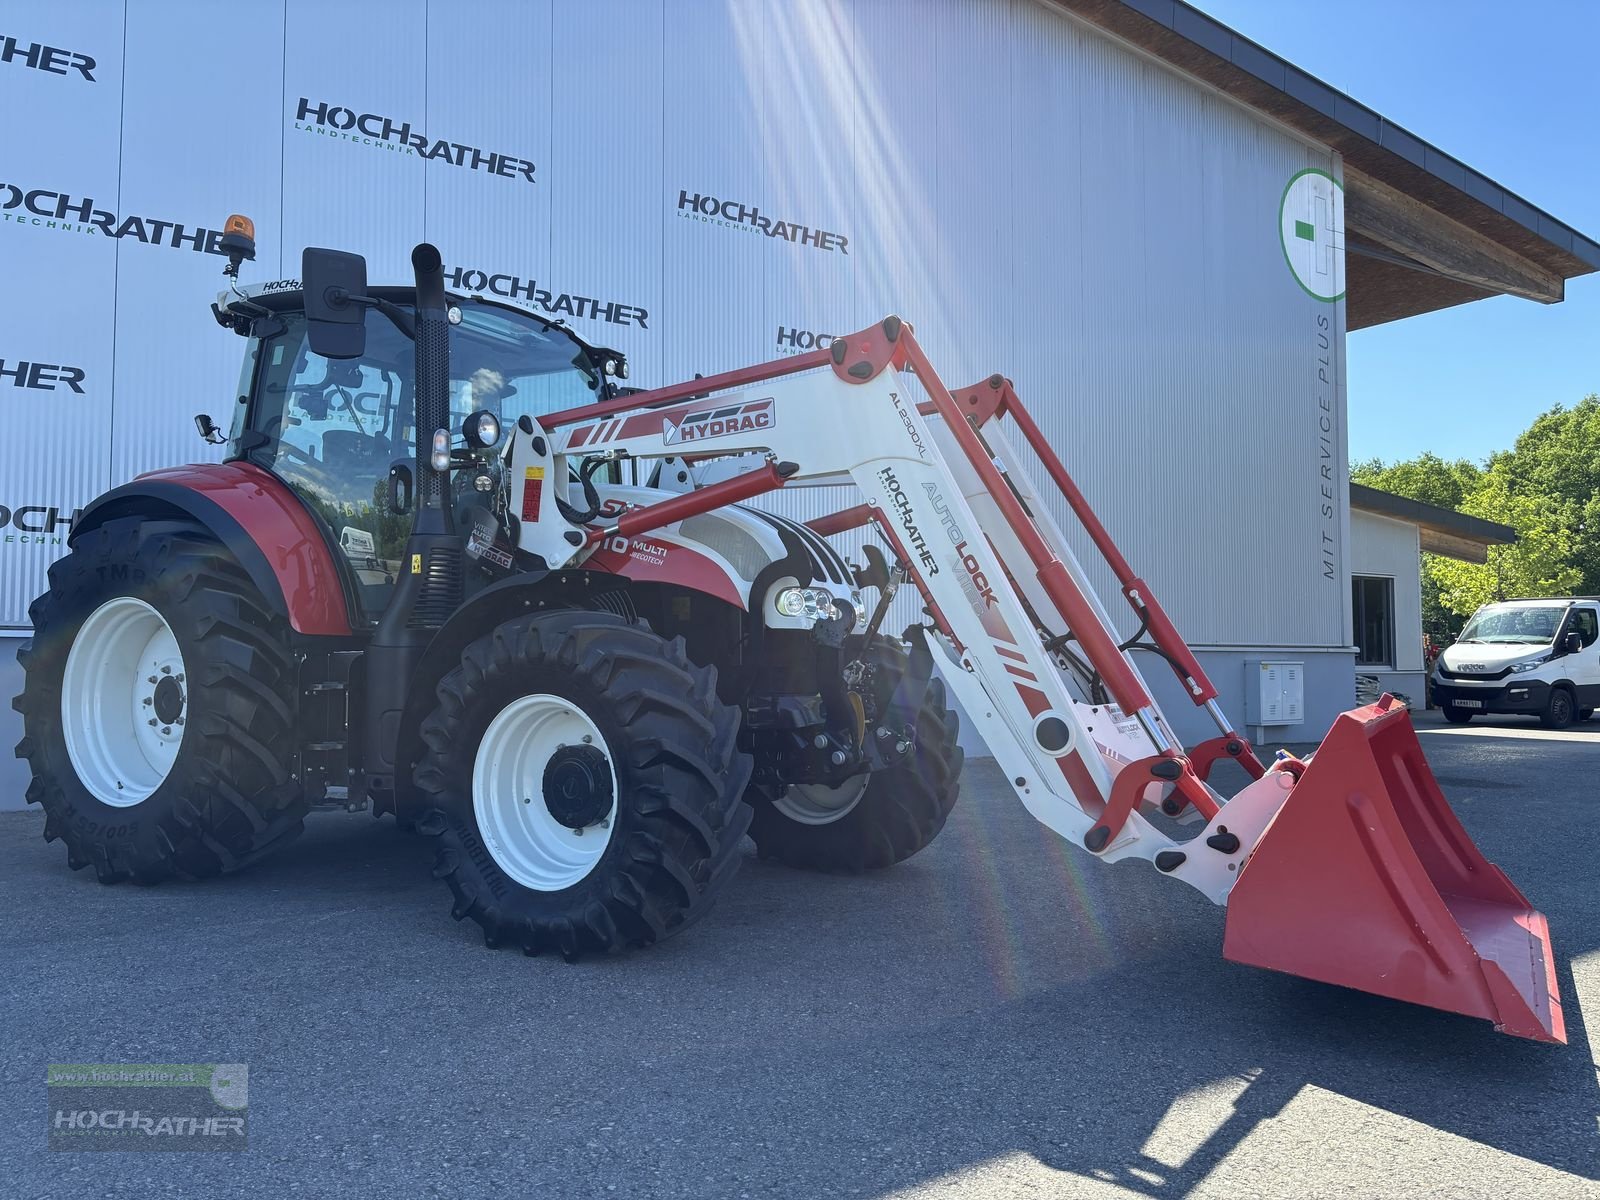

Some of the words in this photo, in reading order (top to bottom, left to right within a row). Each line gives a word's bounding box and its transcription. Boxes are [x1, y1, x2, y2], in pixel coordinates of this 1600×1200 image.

[0, 35, 97, 82] HER
[294, 122, 414, 156] LANDTECHNIK
[296, 97, 536, 184] HOCHRATHER
[0, 183, 256, 261] OCHRATHE
[677, 210, 761, 235] LANDTECHNIK
[678, 190, 848, 255] HOCHRATHER
[777, 326, 837, 350] HOC
[1317, 314, 1329, 385] PLUS
[889, 392, 901, 410] AL
[681, 412, 769, 441] HYDRAC
[1319, 396, 1334, 519] SERVICE
[880, 466, 939, 578] HOCHRATHER
[921, 482, 999, 610] AUTOLOCK
[474, 545, 509, 567] HYDRAC
[632, 540, 668, 557] MULTI
[1323, 531, 1335, 580] MIT
